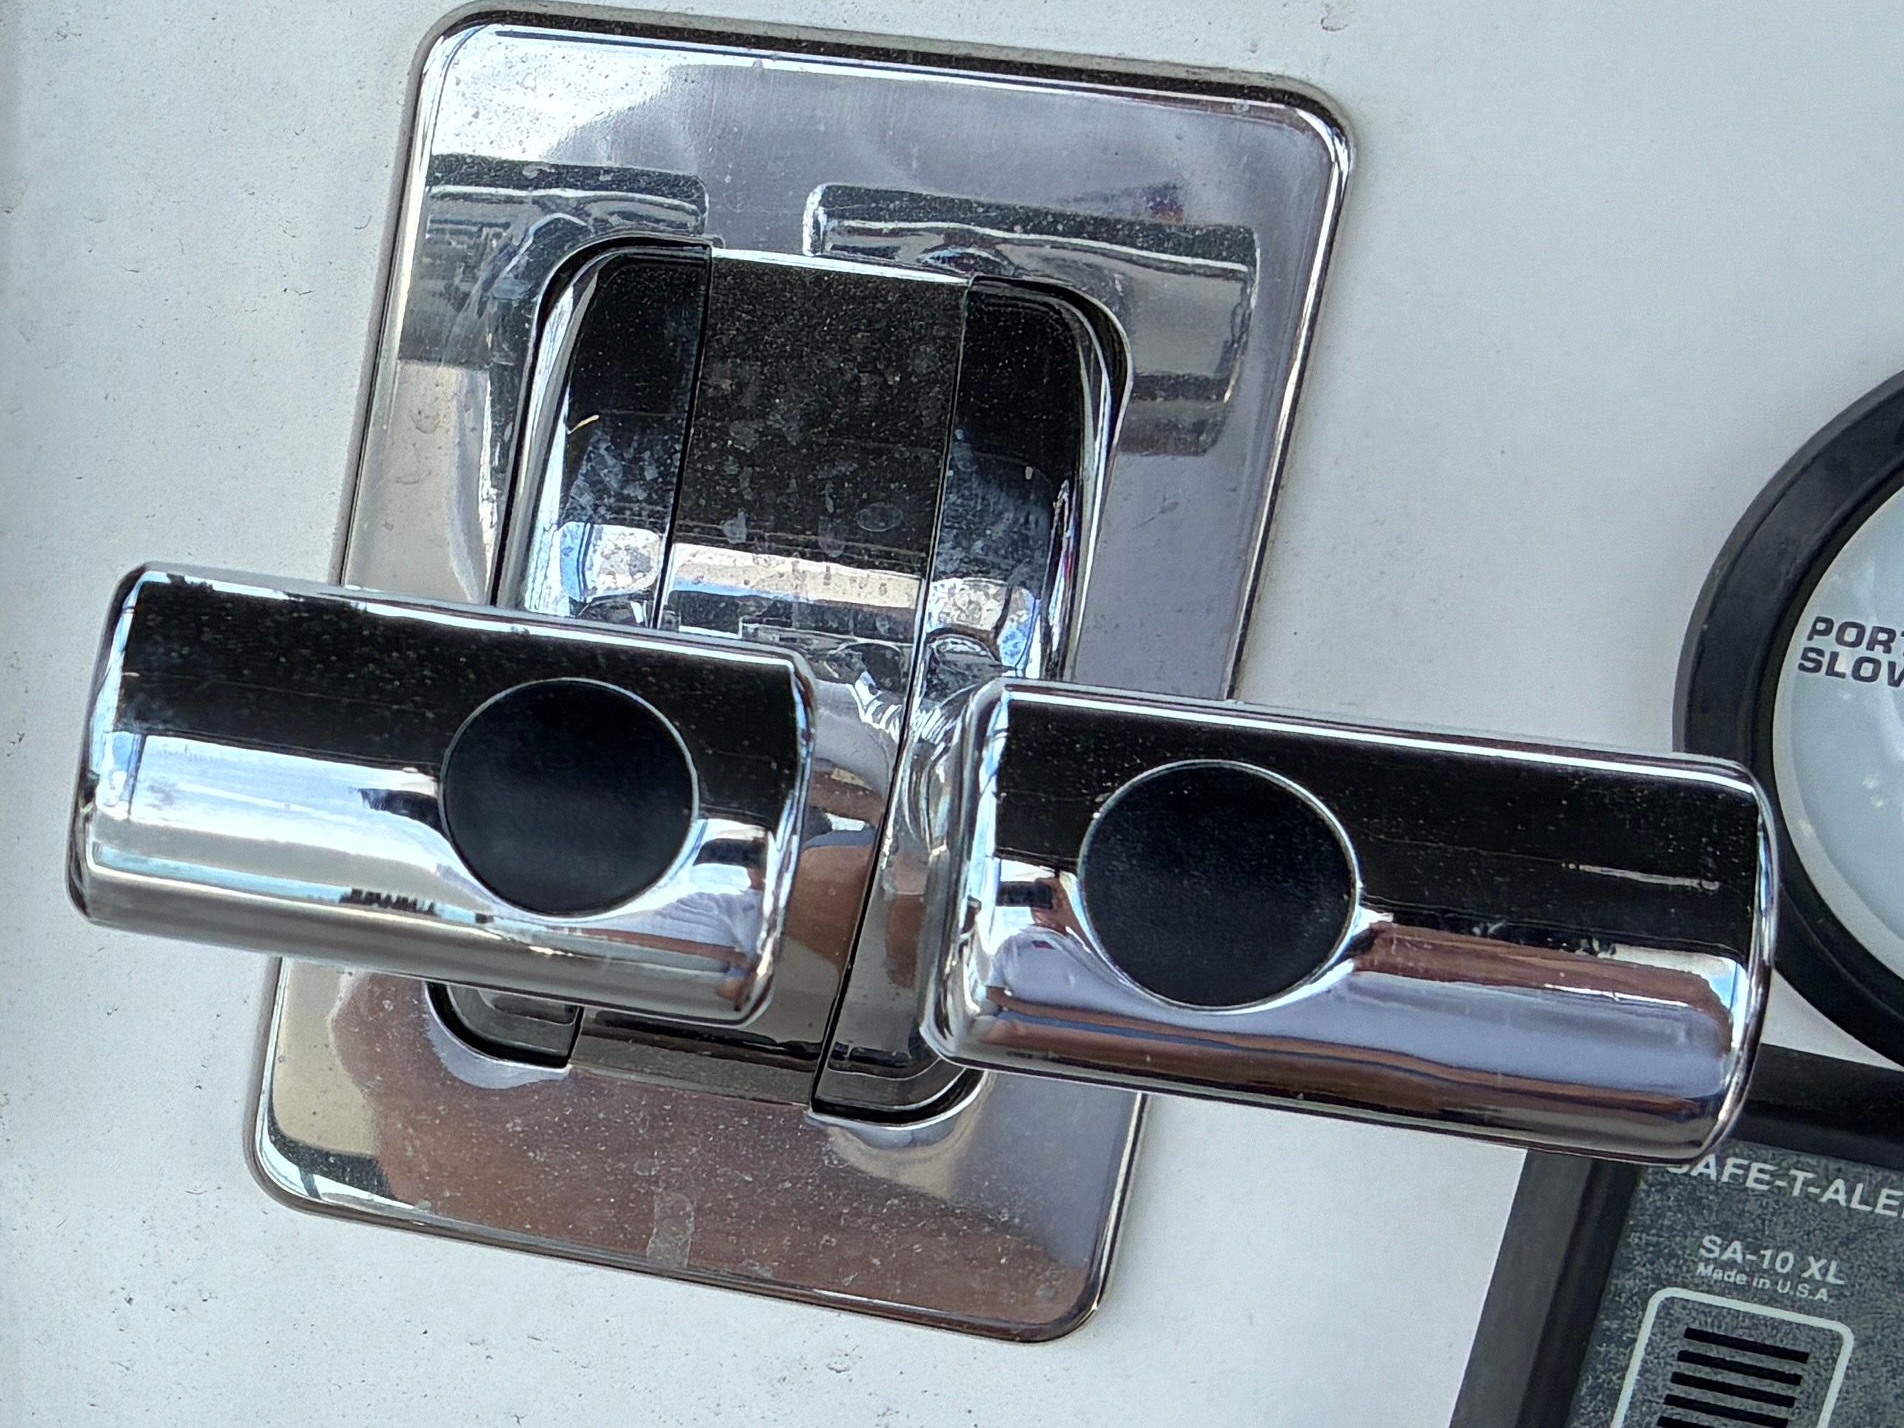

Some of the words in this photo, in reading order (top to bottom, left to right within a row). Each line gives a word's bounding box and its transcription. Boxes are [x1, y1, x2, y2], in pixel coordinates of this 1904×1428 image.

[1807, 616, 1904, 654] POR
[1666, 1154, 1904, 1219] AFE-T-ALE
[1696, 1262, 1747, 1285] Made
[1753, 1276, 1771, 1289] in
[1777, 1280, 1833, 1303] U.S.A.
[1699, 1235, 1794, 1273] SA-10
[1802, 1255, 1845, 1285] XL
